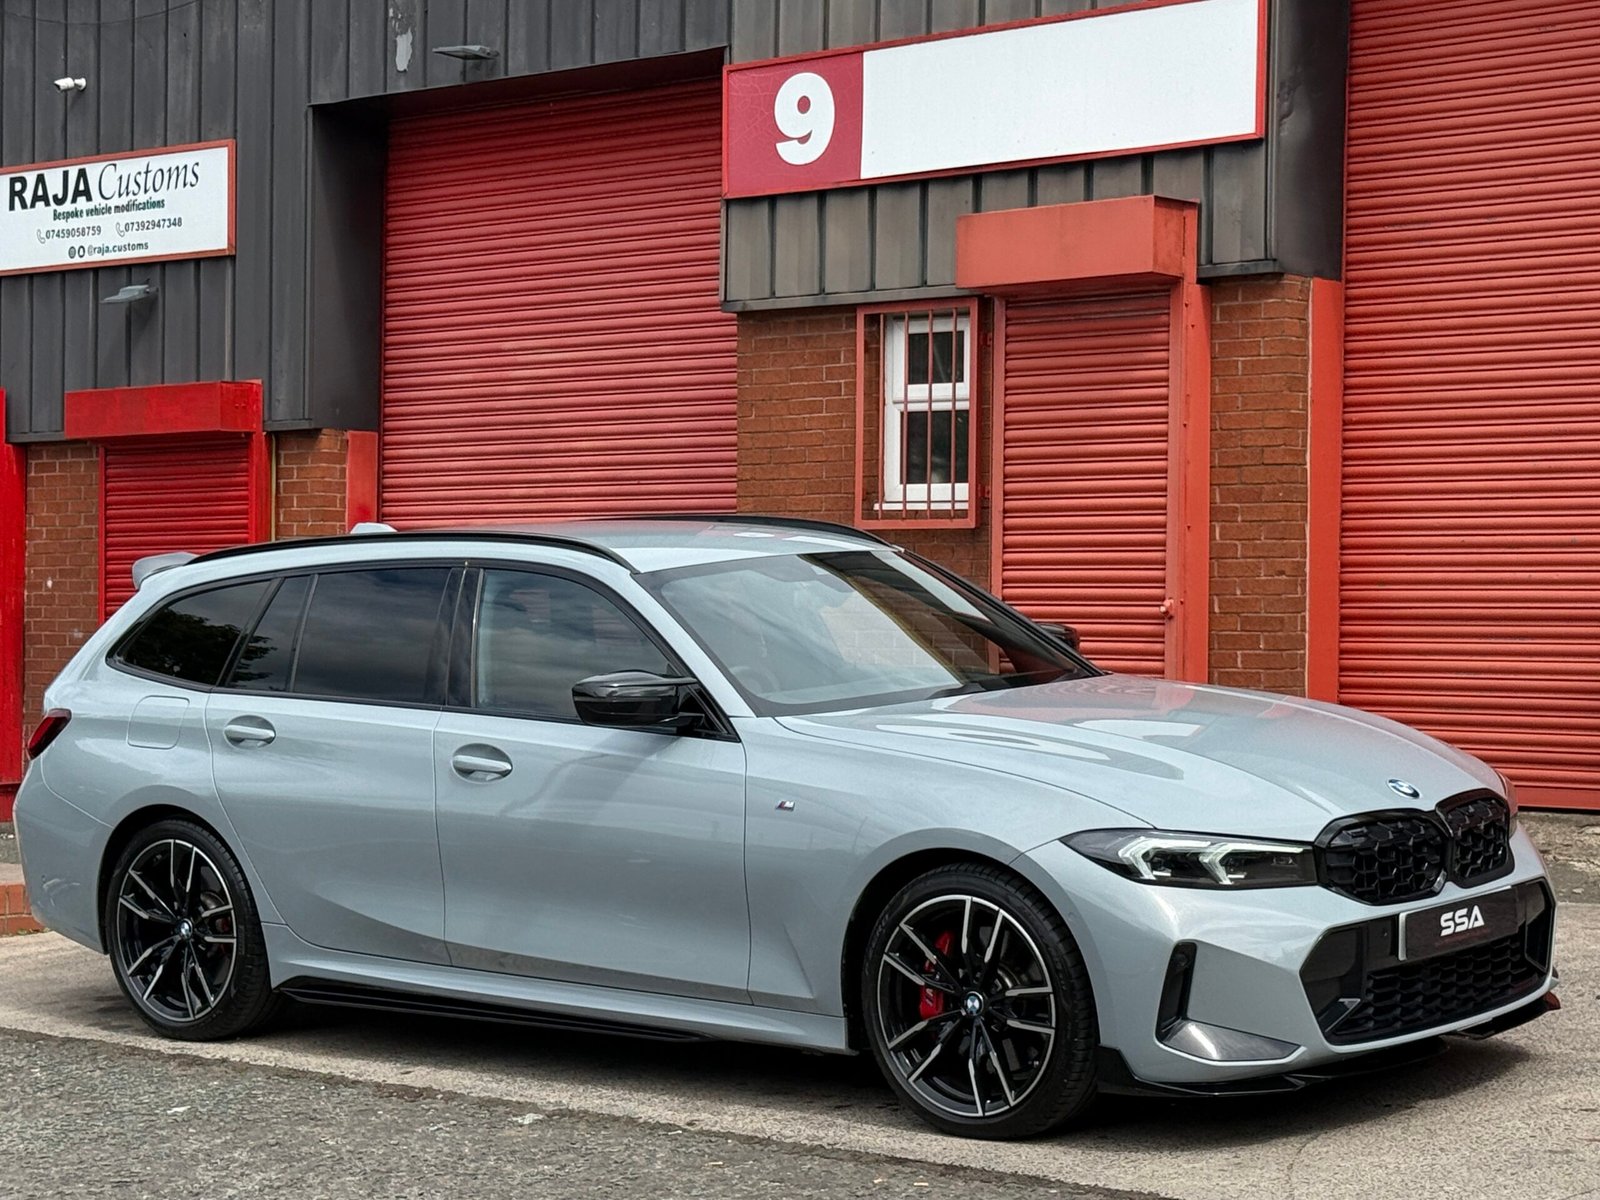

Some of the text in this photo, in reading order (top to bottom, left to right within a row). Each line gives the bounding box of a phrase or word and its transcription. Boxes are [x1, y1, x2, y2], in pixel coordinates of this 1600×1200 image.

[774, 72, 836, 166] 9
[8, 161, 200, 212] RAJA Customs
[53, 197, 166, 222] Bespoke vehicle modifications
[45, 217, 183, 240] 07459058759 07392947348
[87, 241, 149, 257] @raja.customs
[1440, 905, 1485, 937] SSA
